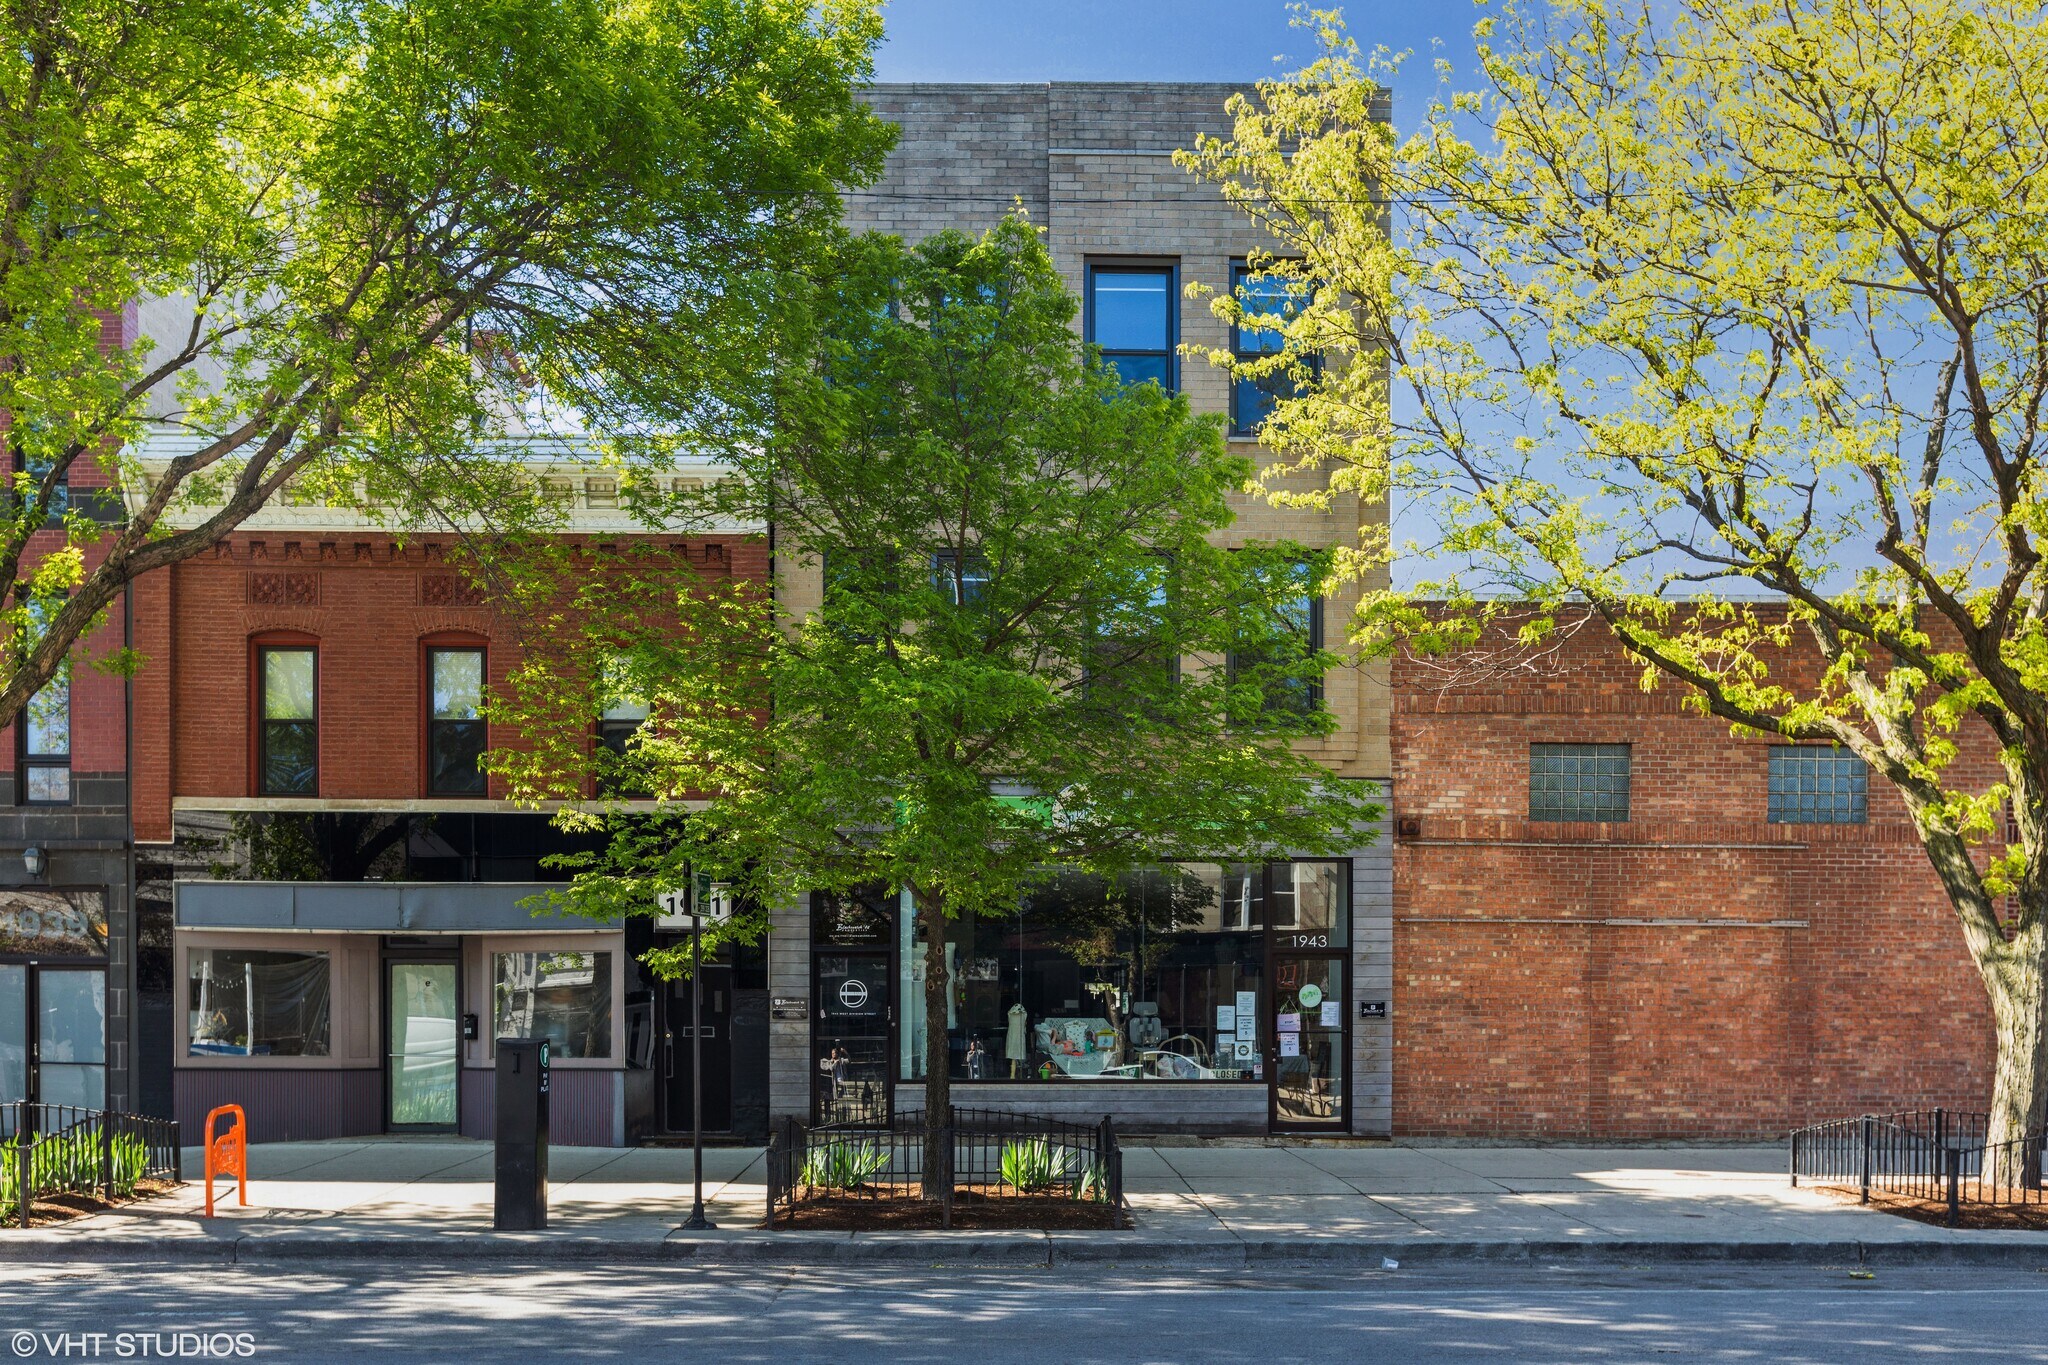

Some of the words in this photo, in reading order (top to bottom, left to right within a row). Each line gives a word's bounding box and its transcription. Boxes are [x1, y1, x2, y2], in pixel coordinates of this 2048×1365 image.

[666, 897, 721, 916] 11
[4, 909, 88, 938] 1939
[1292, 935, 1327, 947] 1943
